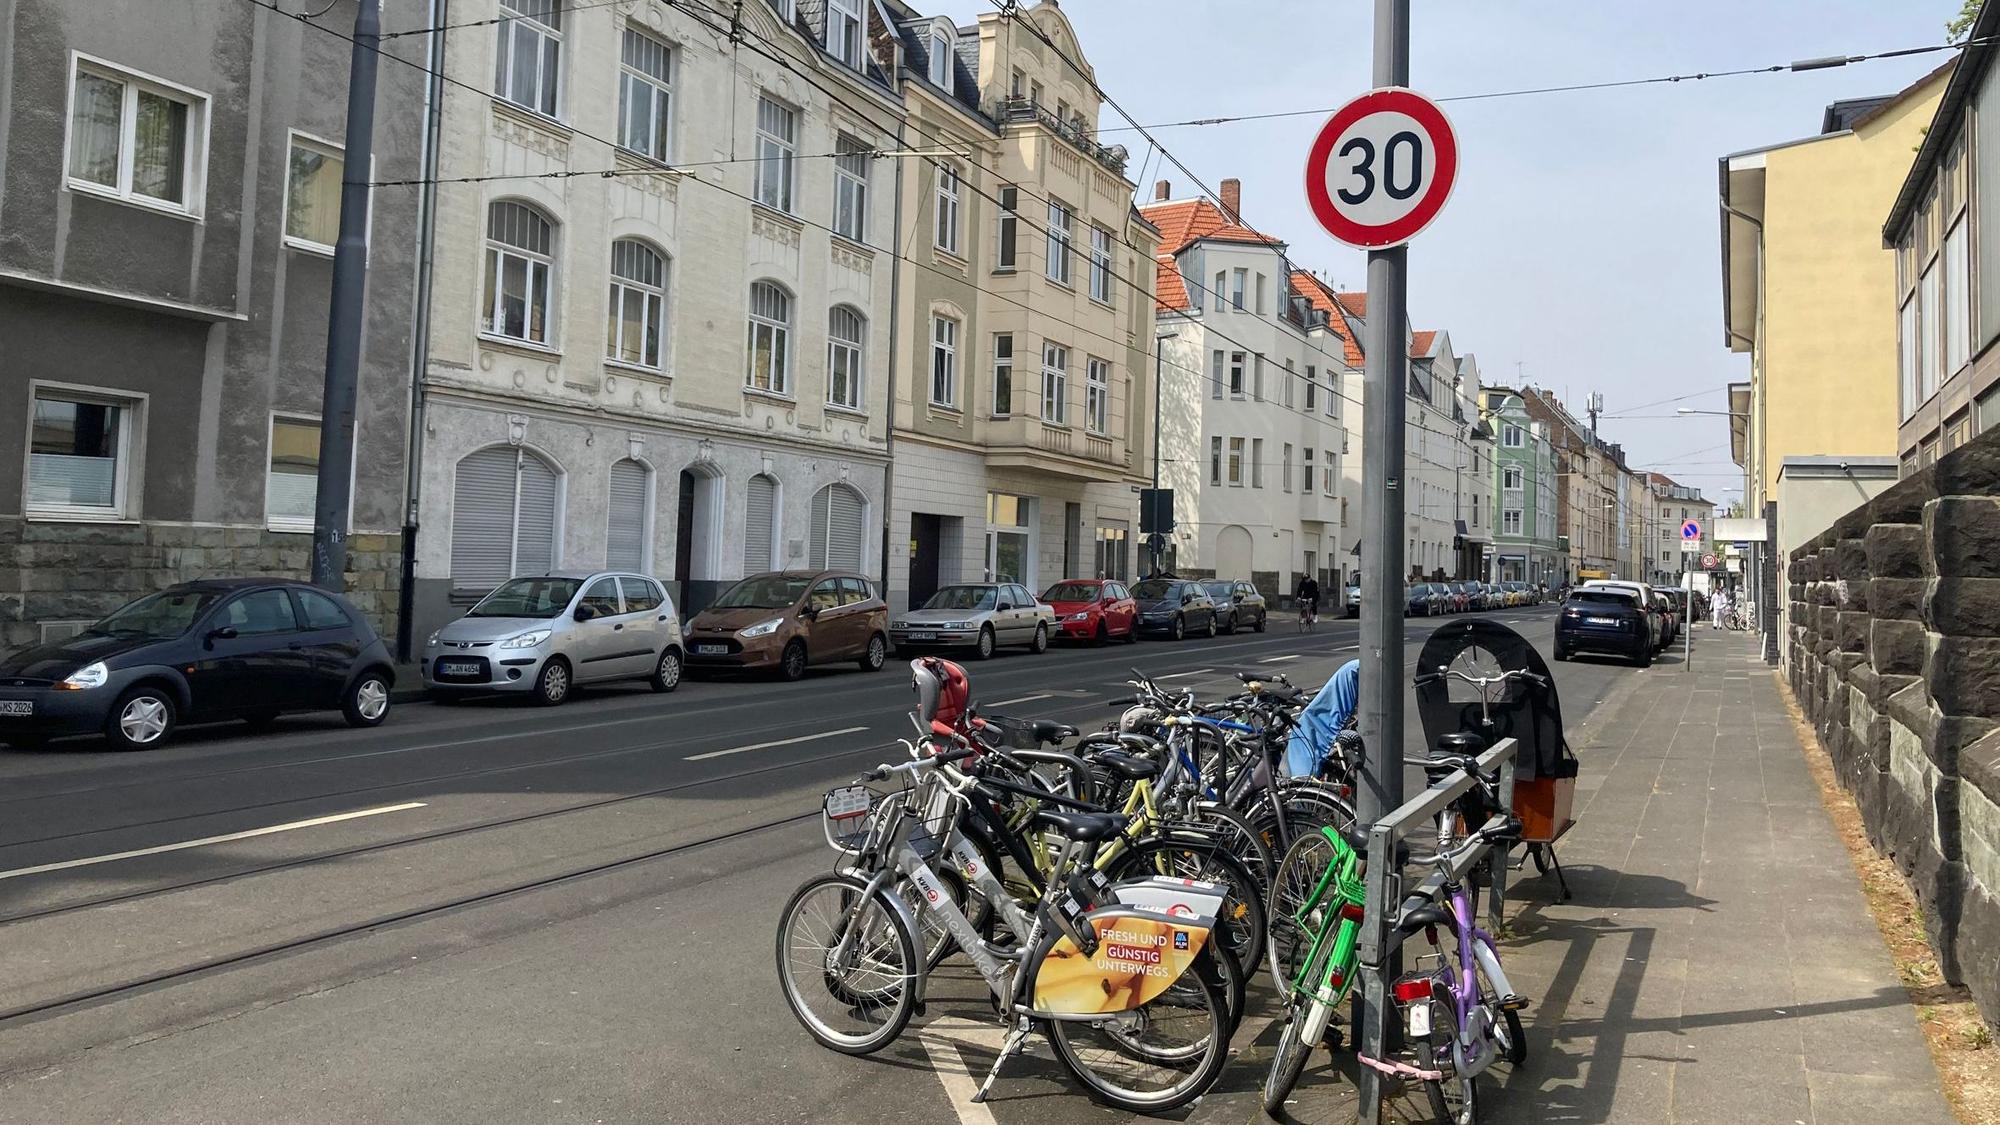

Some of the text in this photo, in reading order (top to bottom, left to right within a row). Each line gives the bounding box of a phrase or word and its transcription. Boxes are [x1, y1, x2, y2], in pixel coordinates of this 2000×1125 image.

[1337, 131, 1422, 205] 30
[958, 851, 971, 864] KVB
[916, 877, 931, 891] KVB
[941, 911, 993, 977] nextbike
[1101, 928, 1168, 947] FRESH UND
[1107, 945, 1160, 963] GÜNSTIG
